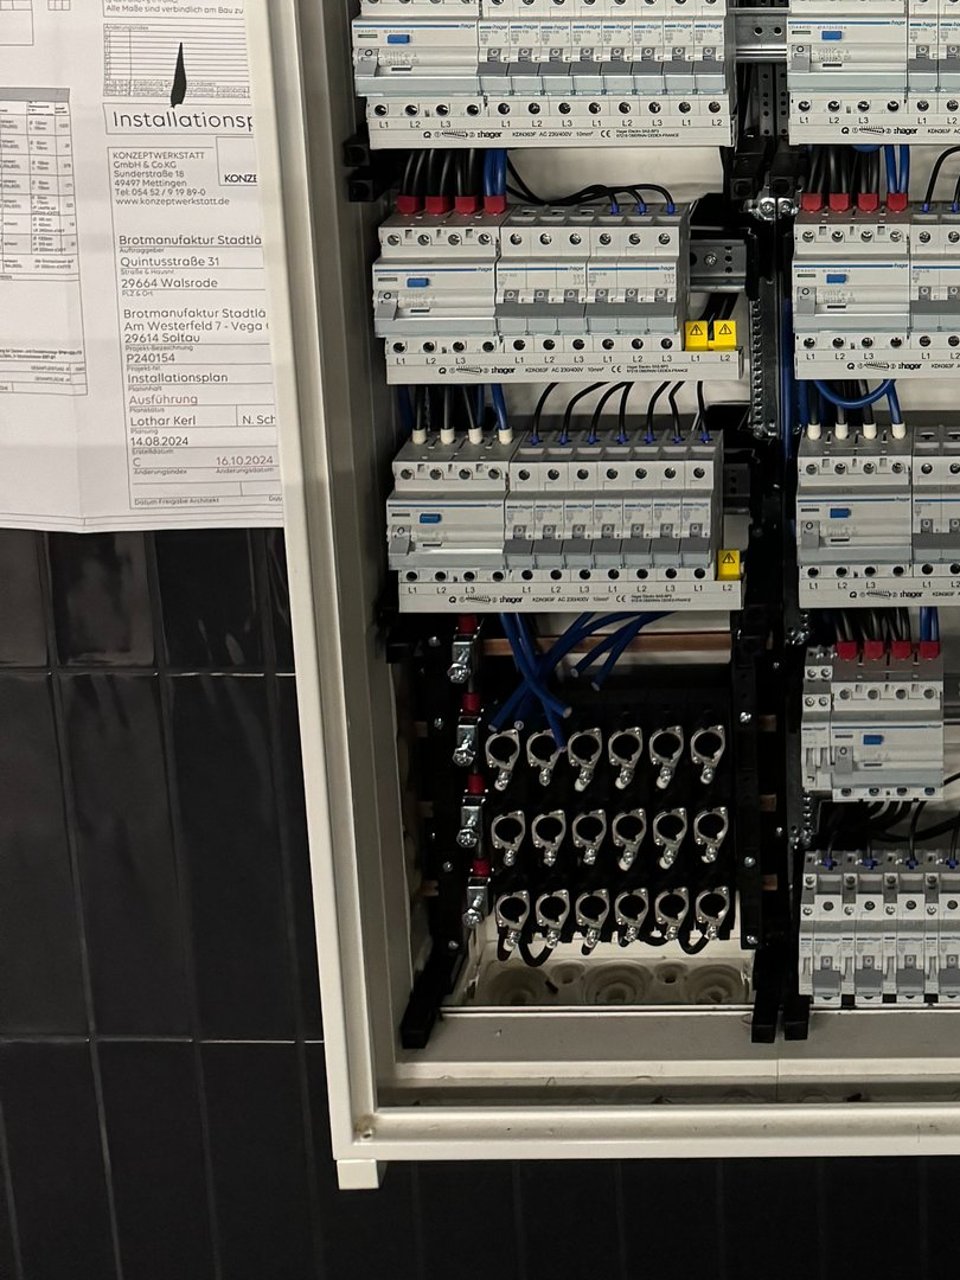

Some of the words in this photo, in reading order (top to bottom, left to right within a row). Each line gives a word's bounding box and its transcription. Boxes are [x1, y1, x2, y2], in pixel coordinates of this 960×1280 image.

[114, 170, 173, 178] Sunderstraße
[142, 180, 187, 188] Mettingen
[116, 198, 230, 206] www.konzeptwerkstatt.de
[120, 235, 214, 245] Brotmanufaktur
[121, 257, 205, 267] Quintusstraße
[208, 257, 219, 266] 31
[122, 279, 157, 288] 29664
[161, 278, 218, 288] Walsrode
[124, 309, 219, 318] Brotmanufaktur
[124, 322, 144, 331] Am
[148, 321, 212, 330] Westerfeld
[216, 322, 221, 330] 7
[231, 322, 262, 333] Vega
[125, 334, 158, 343] 29614
[162, 333, 200, 342] Soltau
[127, 353, 175, 363] P240154
[455, 357, 466, 365] L3
[544, 356, 554, 364] L2
[573, 356, 584, 364] L3
[632, 355, 642, 363] L2
[128, 373, 228, 384] Installationsplan
[129, 394, 198, 405] Ausführung
[131, 416, 170, 426] Lothar
[174, 416, 196, 425] Kerl
[243, 416, 253, 424] N.
[131, 437, 188, 446] 14.08.2024
[133, 457, 141, 467] C
[216, 456, 273, 465] 16.10.2024
